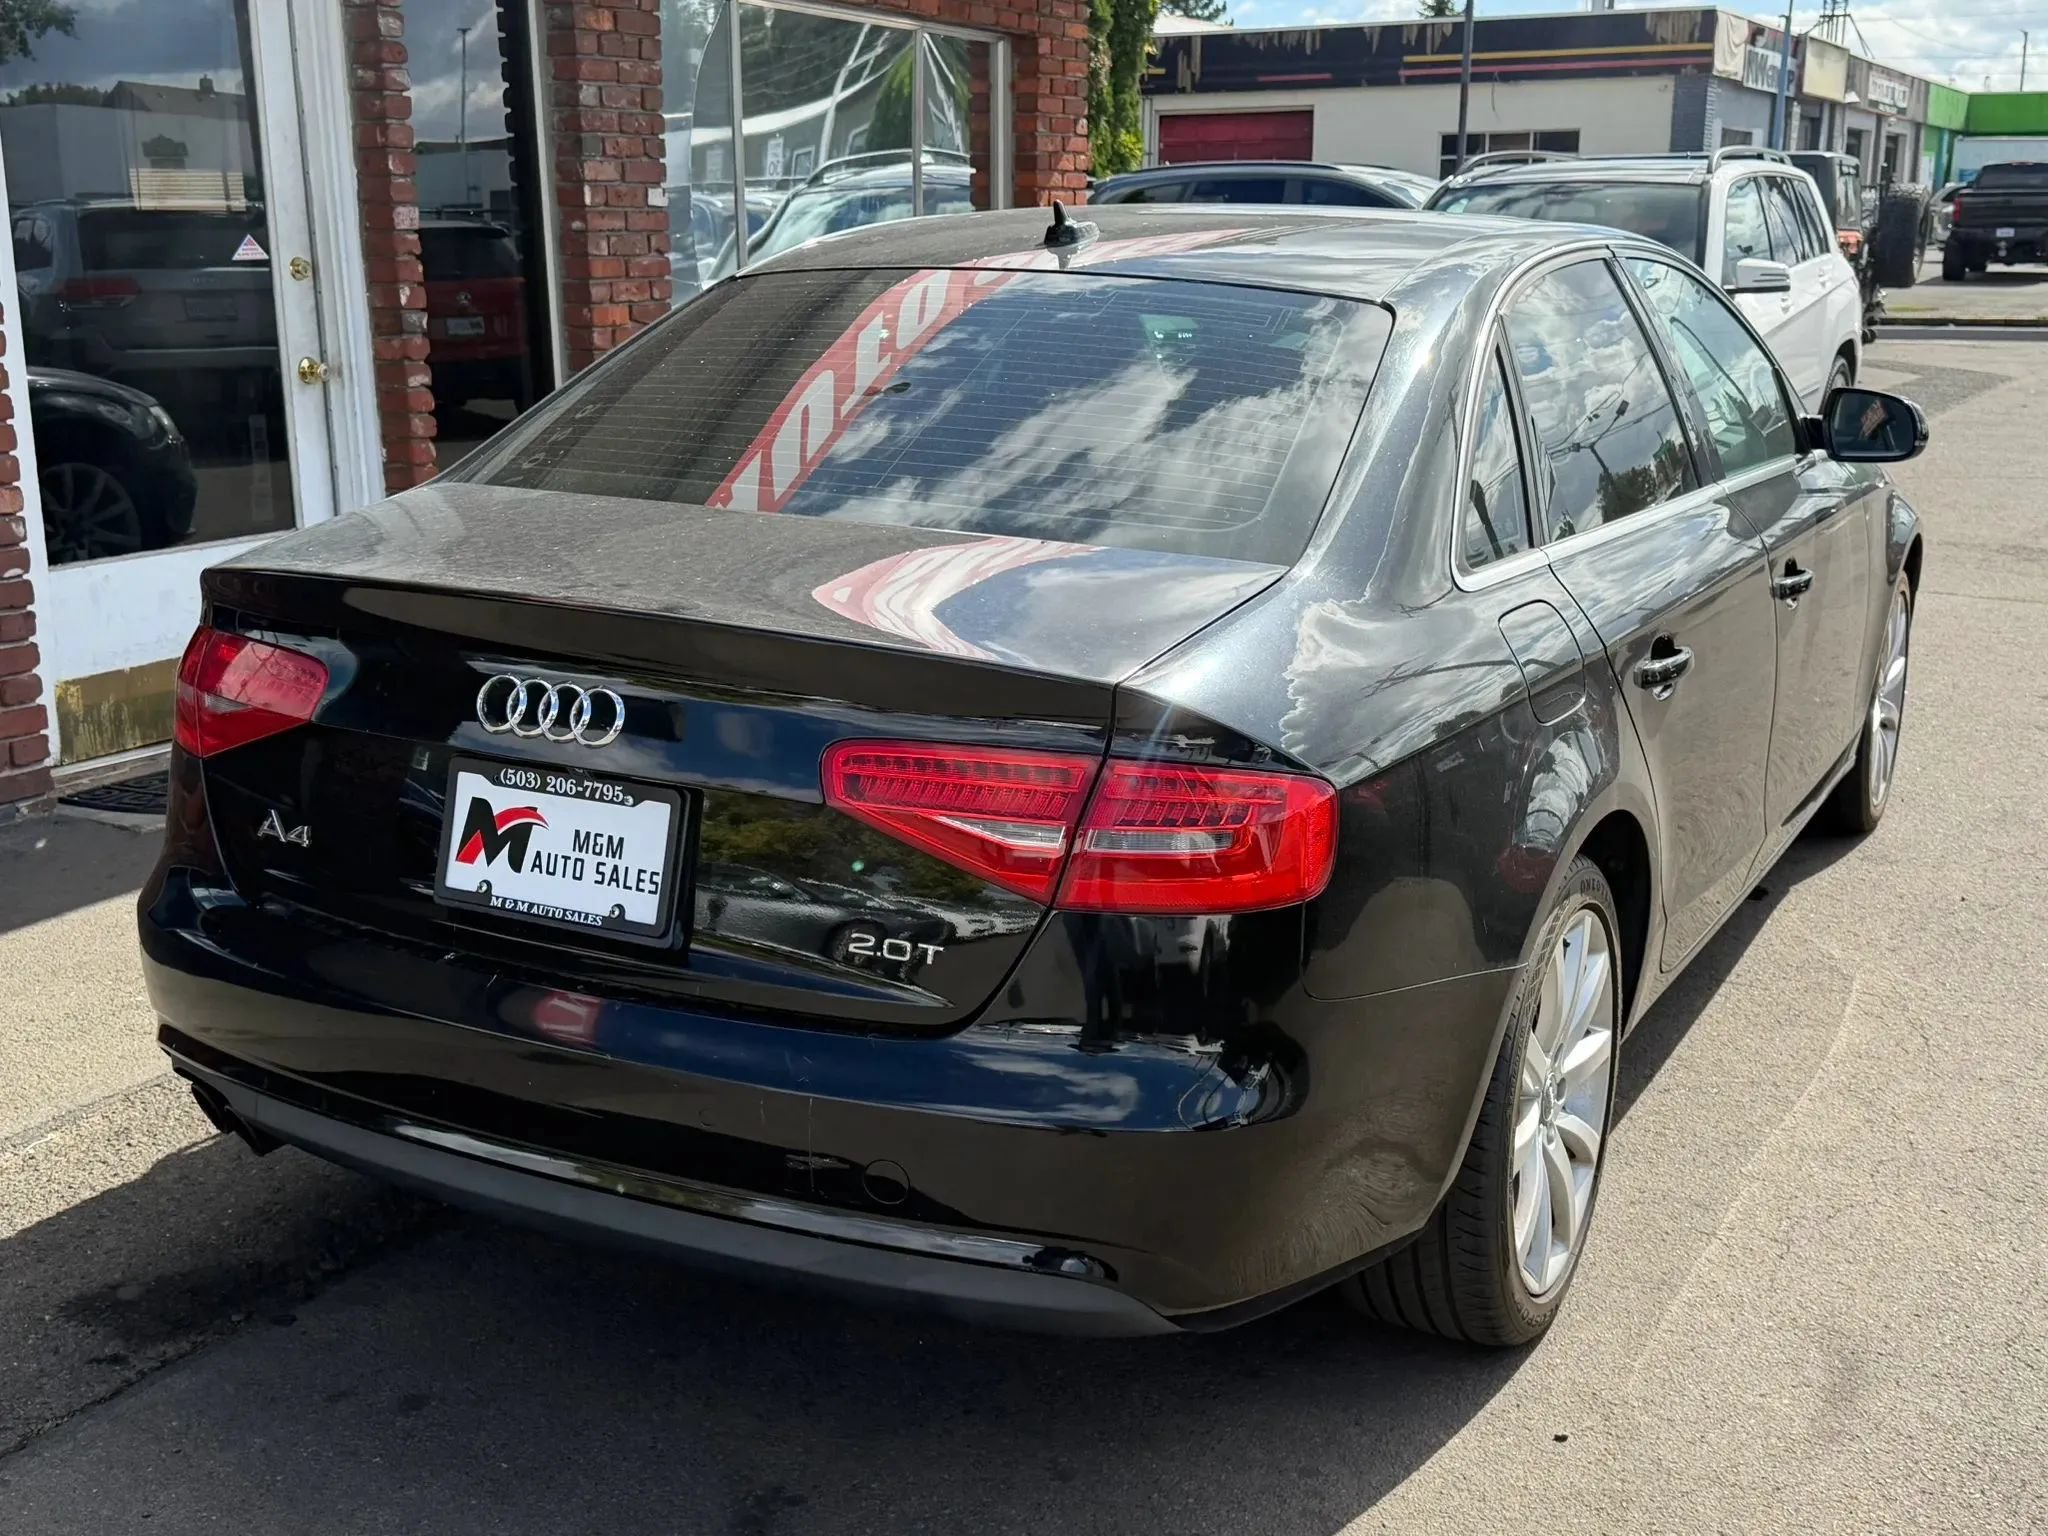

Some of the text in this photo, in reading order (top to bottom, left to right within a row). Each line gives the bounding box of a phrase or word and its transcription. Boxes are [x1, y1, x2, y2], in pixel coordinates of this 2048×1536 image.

[500, 767, 624, 803] (503) 206-7795
[257, 808, 312, 848] A4
[572, 828, 625, 860] M&M
[530, 850, 660, 896] AUTO SALES
[489, 895, 603, 927] M & M AUTO SALES
[848, 932, 944, 965] 2.0T
